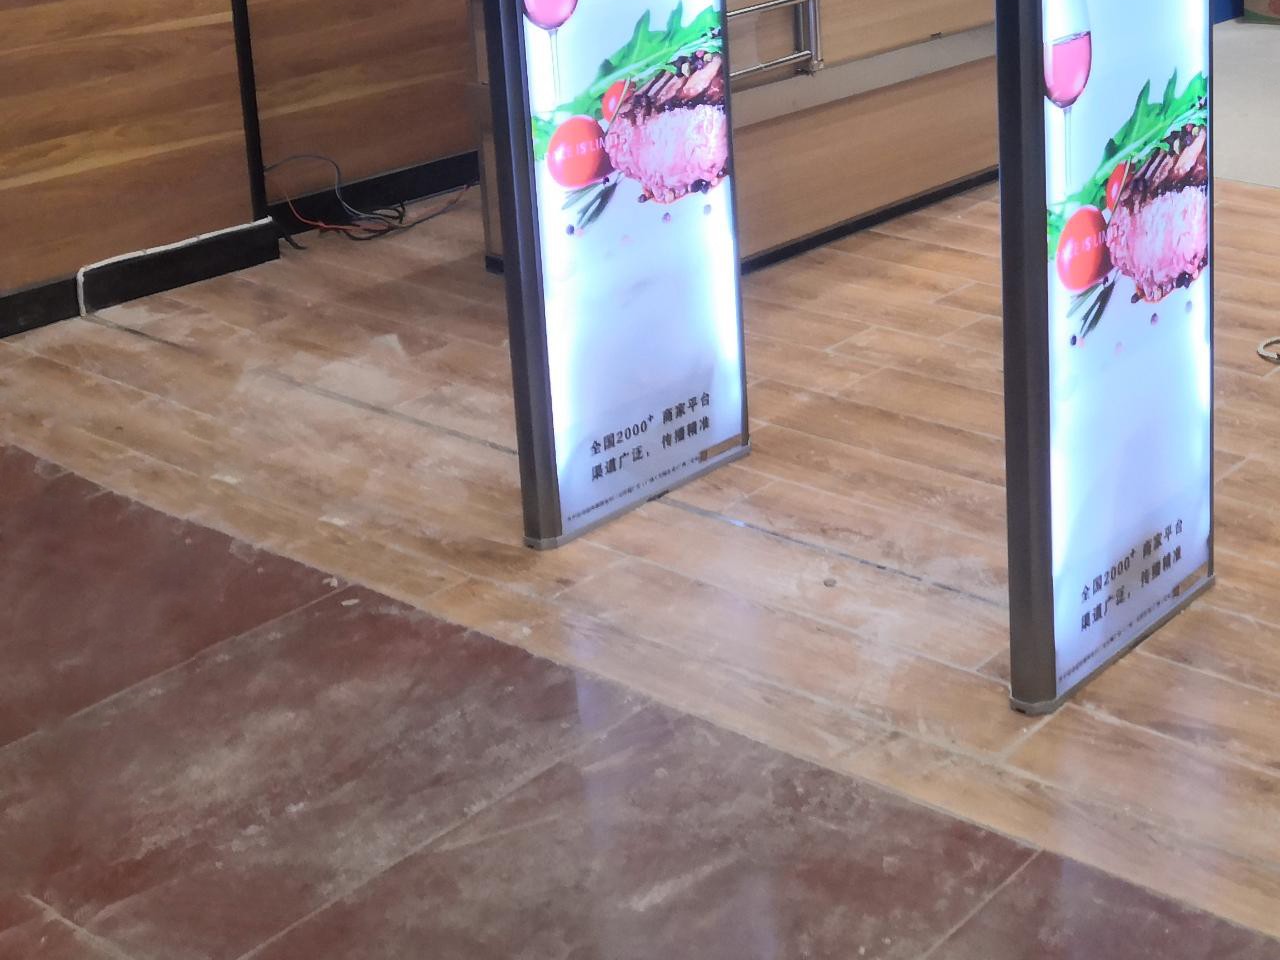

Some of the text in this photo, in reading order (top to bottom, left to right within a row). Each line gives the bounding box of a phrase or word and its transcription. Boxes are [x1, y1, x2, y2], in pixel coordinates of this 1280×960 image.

[662, 391, 711, 425] 商家平台
[661, 415, 711, 450] 传播精准
[1142, 518, 1183, 560] 商家平台
